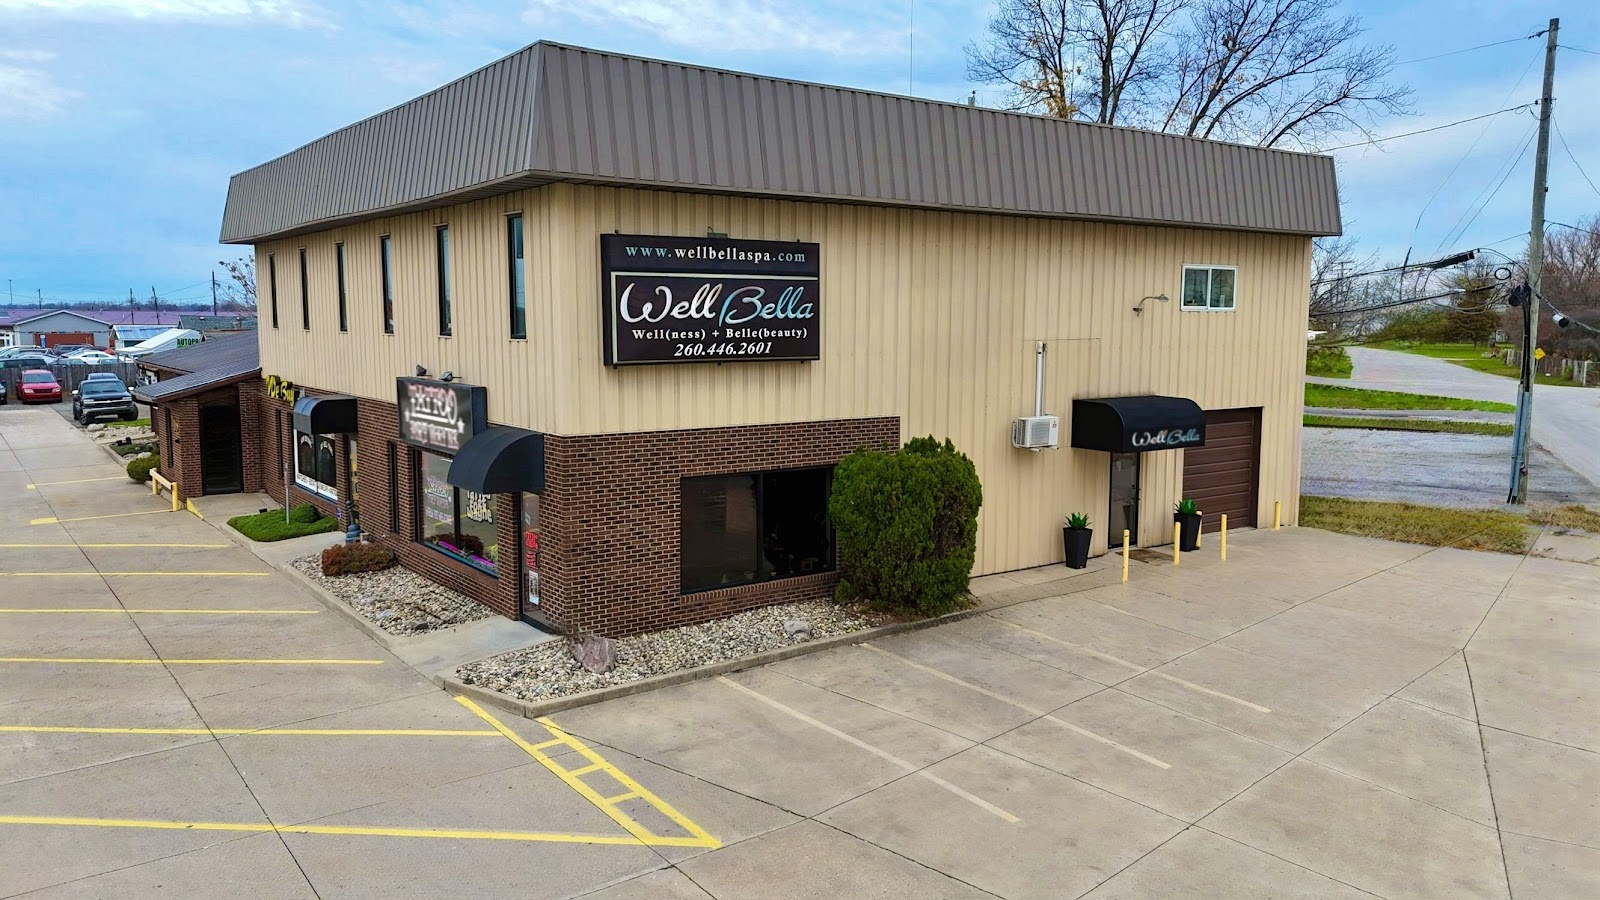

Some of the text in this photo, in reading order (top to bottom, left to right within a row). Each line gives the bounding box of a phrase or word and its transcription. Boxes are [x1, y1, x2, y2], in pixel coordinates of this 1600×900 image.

[625, 245, 806, 264] www.wellbellaspa.com
[619, 282, 814, 327] Well Bella
[630, 327, 808, 341] Well(ness) + Belle(beauty)
[673, 341, 773, 357] 260.446.2601
[1131, 428, 1200, 447] Well Bella
